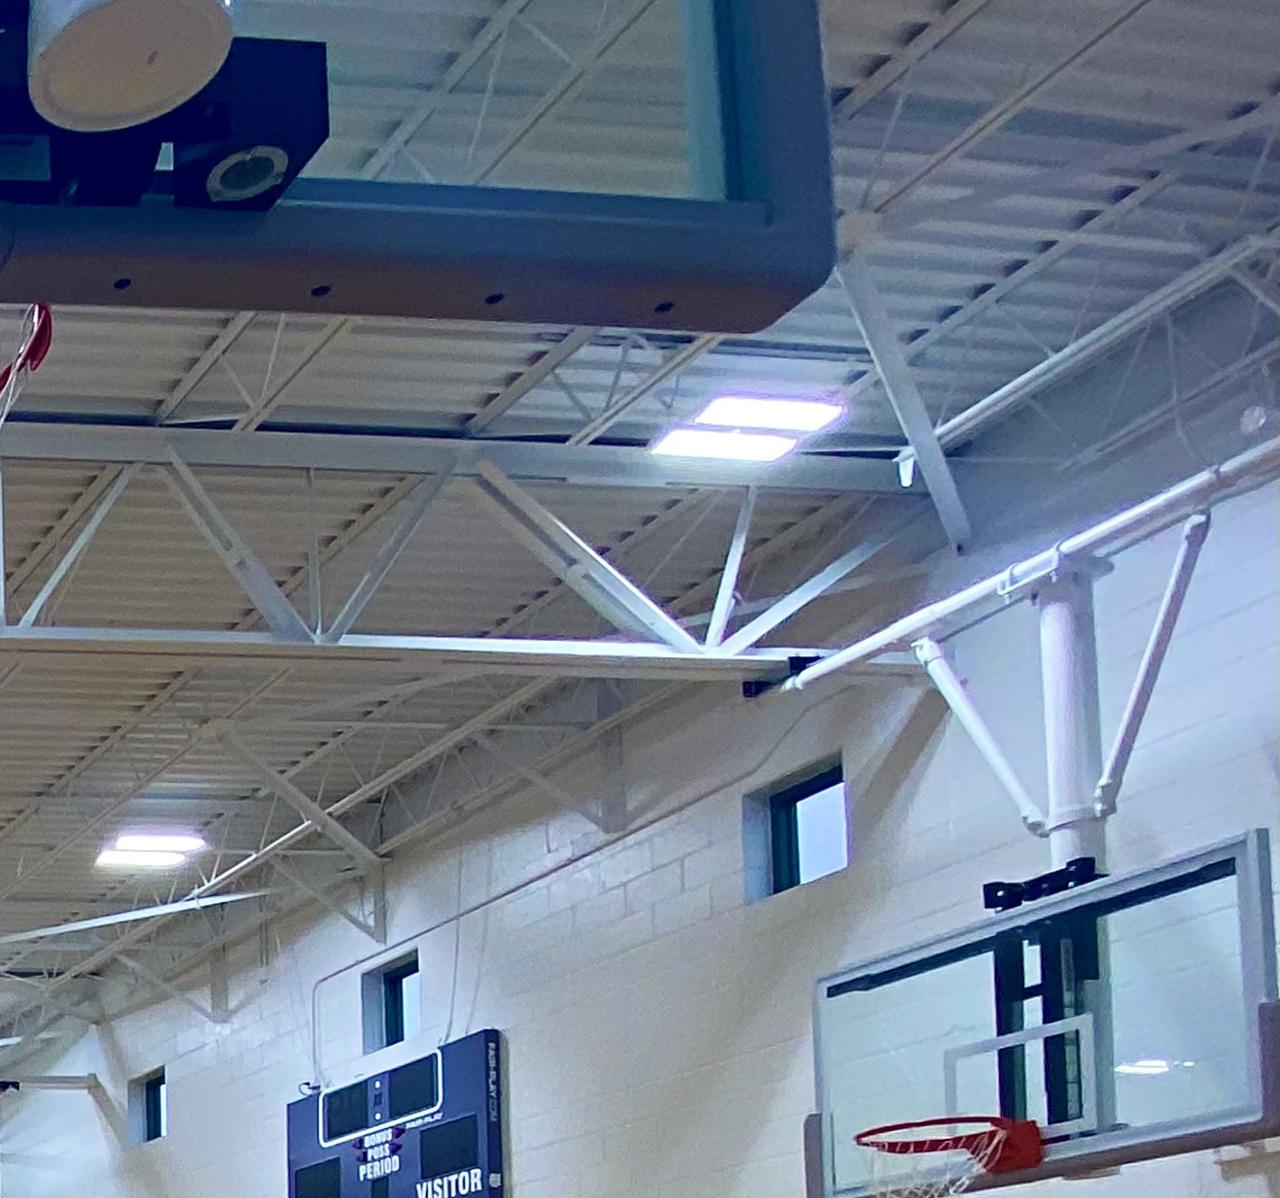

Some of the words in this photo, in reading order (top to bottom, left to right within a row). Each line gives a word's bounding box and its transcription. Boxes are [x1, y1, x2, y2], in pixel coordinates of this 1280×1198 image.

[364, 1128, 392, 1148] BONUS
[367, 1143, 390, 1161] POSS
[359, 1155, 400, 1181] PERIOD
